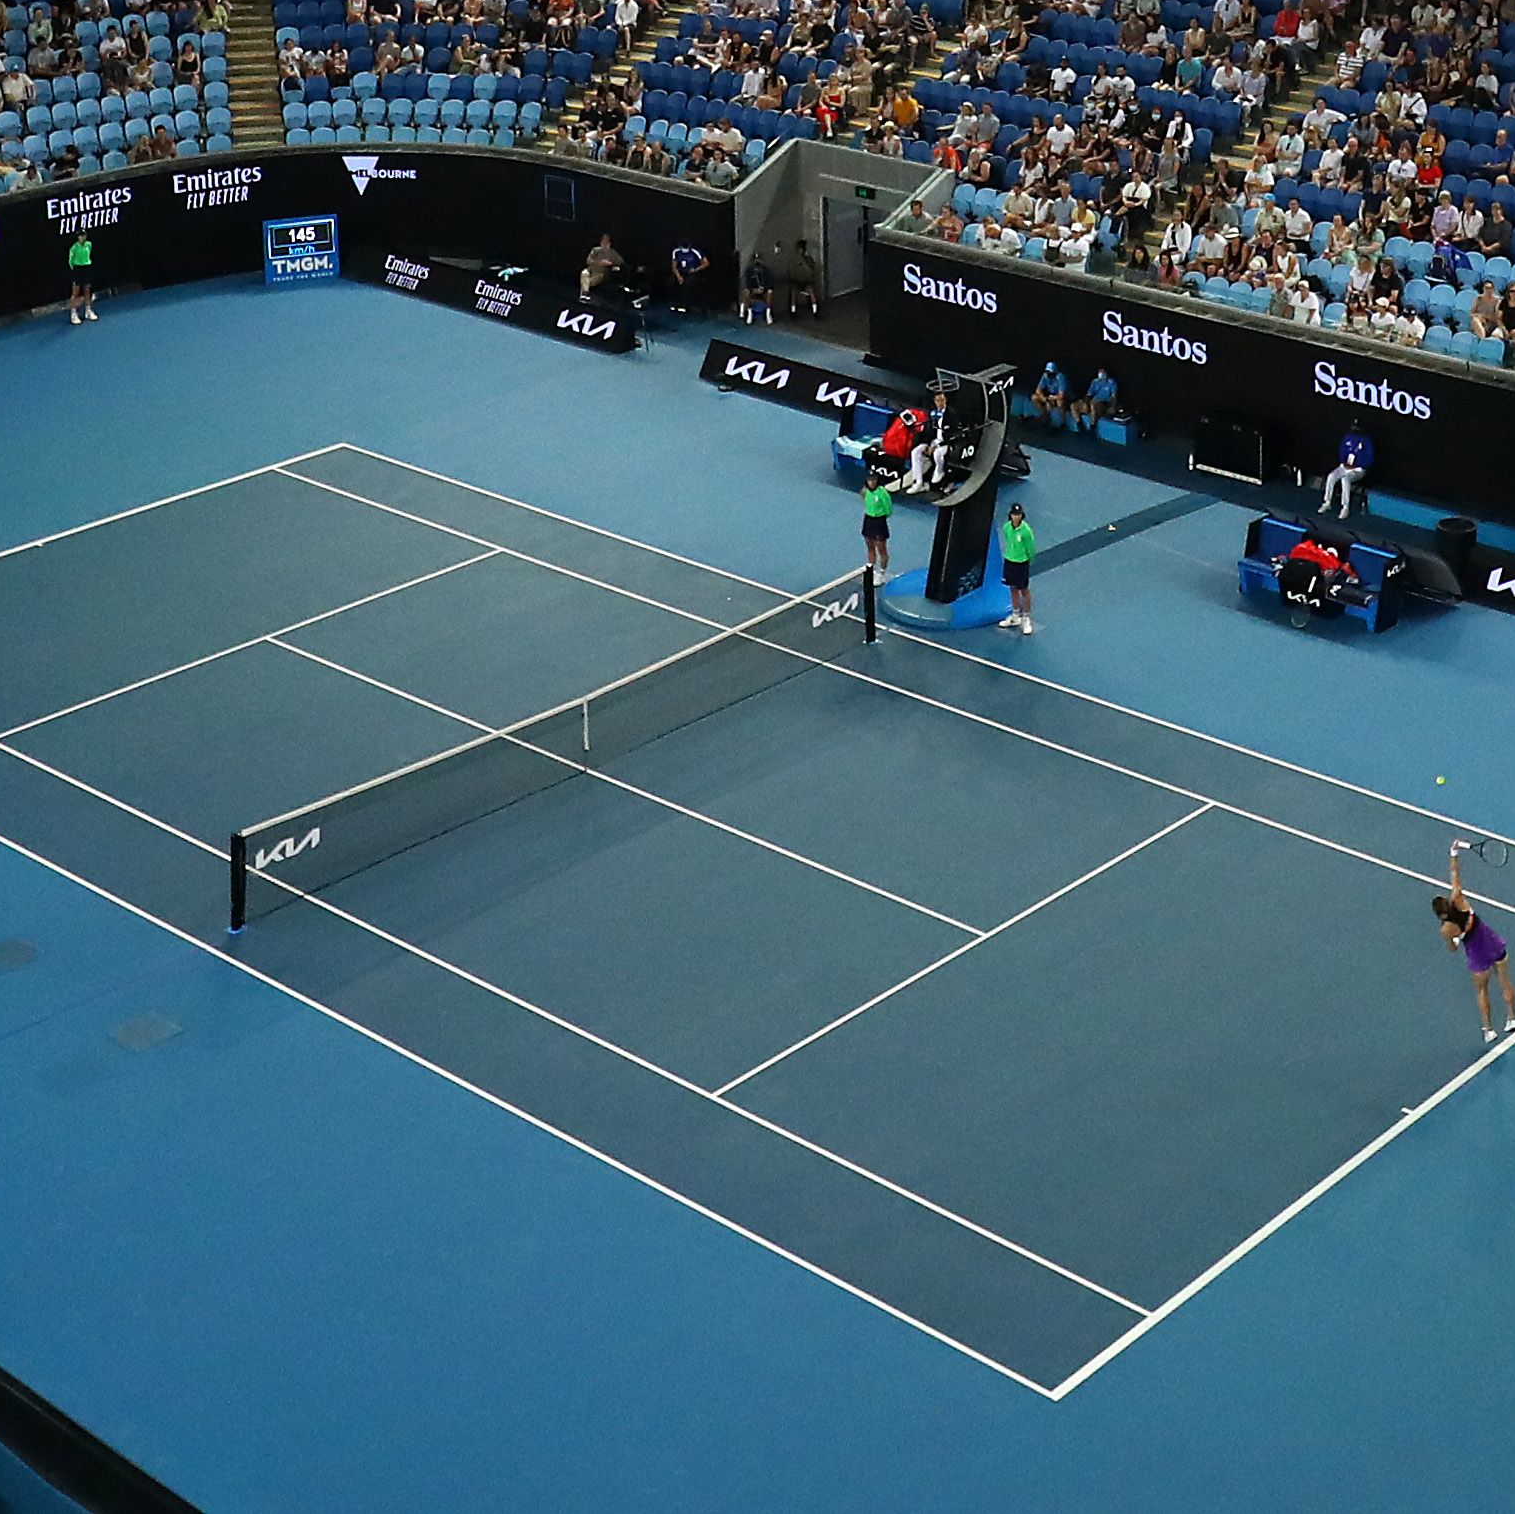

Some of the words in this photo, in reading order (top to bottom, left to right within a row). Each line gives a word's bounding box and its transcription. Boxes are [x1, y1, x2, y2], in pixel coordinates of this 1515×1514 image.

[172, 166, 263, 194] Emirates
[46, 186, 133, 219] Emirates
[186, 192, 205, 210] FLY
[208, 185, 249, 206] BETTER
[59, 216, 77, 235] FLY
[79, 206, 119, 229] BETTER
[288, 226, 315, 242] 145
[385, 254, 430, 280] Emirates
[474, 279, 522, 306] Emirates
[903, 263, 998, 314] Santos
[556, 309, 616, 340] KIA
[1102, 310, 1207, 365] Santos
[724, 355, 791, 389] KIA
[816, 382, 857, 408] KI
[1314, 361, 1432, 420] Santos
[811, 592, 859, 628] KIA
[255, 827, 321, 869] KIA
